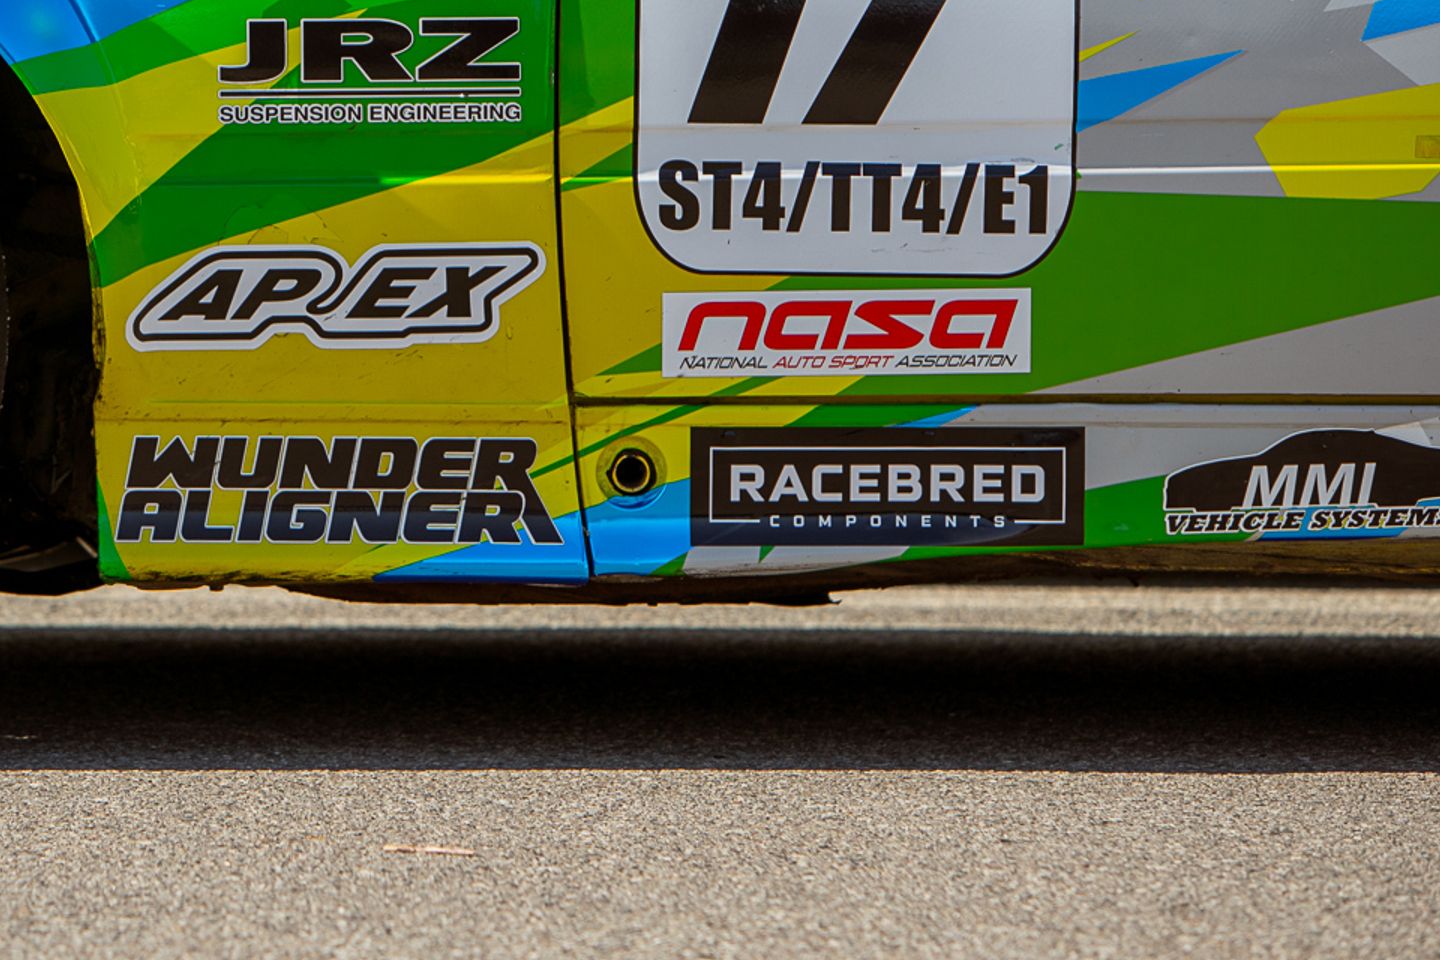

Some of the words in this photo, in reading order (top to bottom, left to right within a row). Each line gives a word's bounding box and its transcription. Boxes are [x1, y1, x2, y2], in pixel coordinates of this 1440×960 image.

[218, 18, 521, 83] JRZ
[218, 104, 361, 123] SUSPENSION
[370, 103, 521, 122] ENGINEERING
[659, 159, 1049, 235] ST4/TT4/E1
[142, 254, 530, 332] APEX
[679, 355, 768, 369] NATIONAL
[772, 355, 826, 368] AUTO
[828, 355, 894, 368] SPORT
[895, 354, 1019, 368] ASSOCIATION
[125, 436, 550, 492] WUNDER
[730, 464, 1046, 502] RACEBRED
[1241, 462, 1377, 508] MMI
[115, 489, 530, 545] ALIGNER
[769, 514, 1006, 528] COMPONENTS
[1164, 511, 1306, 535] VEHICLE
[1308, 507, 1440, 530] SYSTEM
